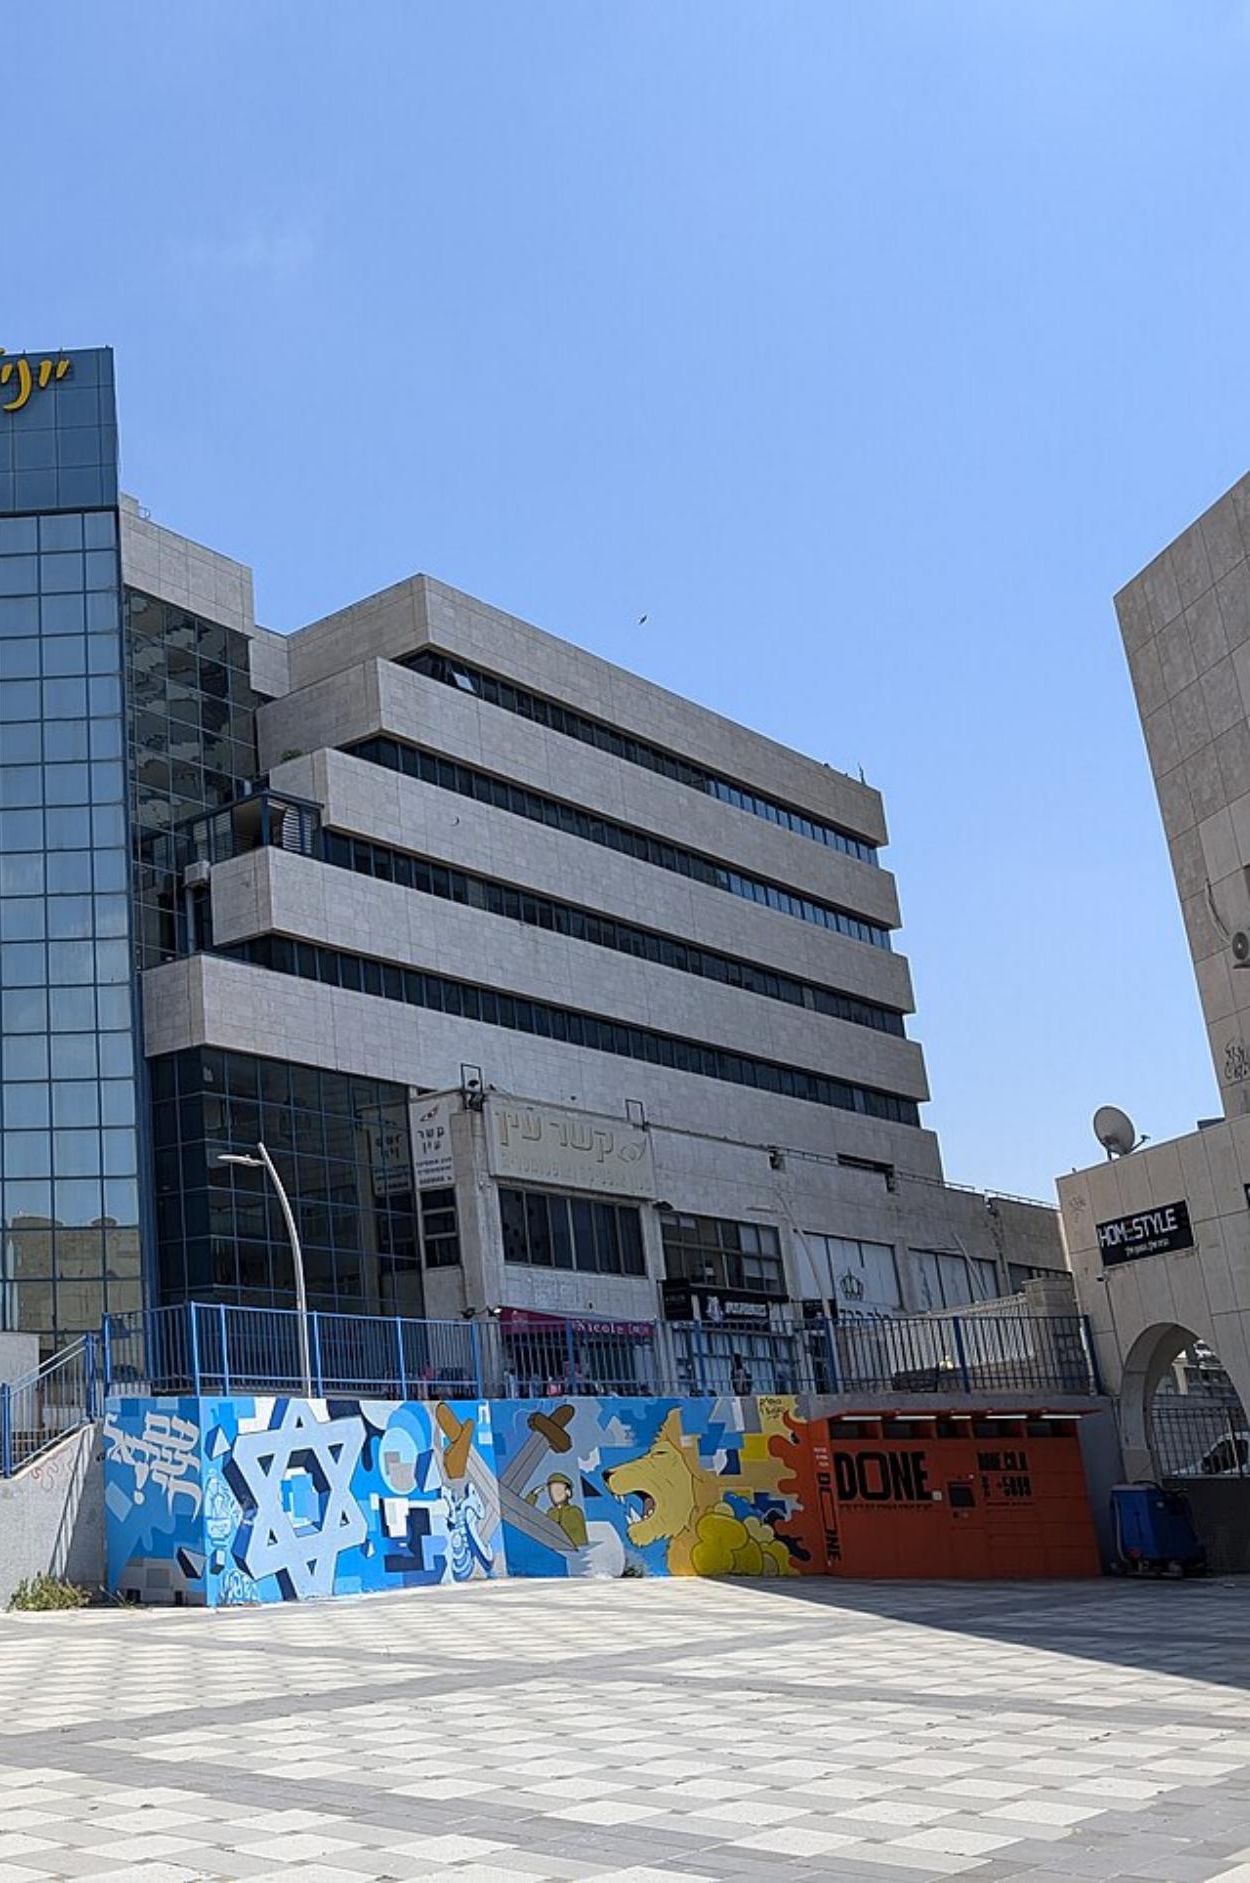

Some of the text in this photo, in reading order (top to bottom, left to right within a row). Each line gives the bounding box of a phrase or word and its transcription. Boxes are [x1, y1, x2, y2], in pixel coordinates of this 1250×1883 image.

[417, 1126, 445, 1140] קשר
[495, 1107, 614, 1163] קשר עין
[422, 1140, 442, 1155] עין
